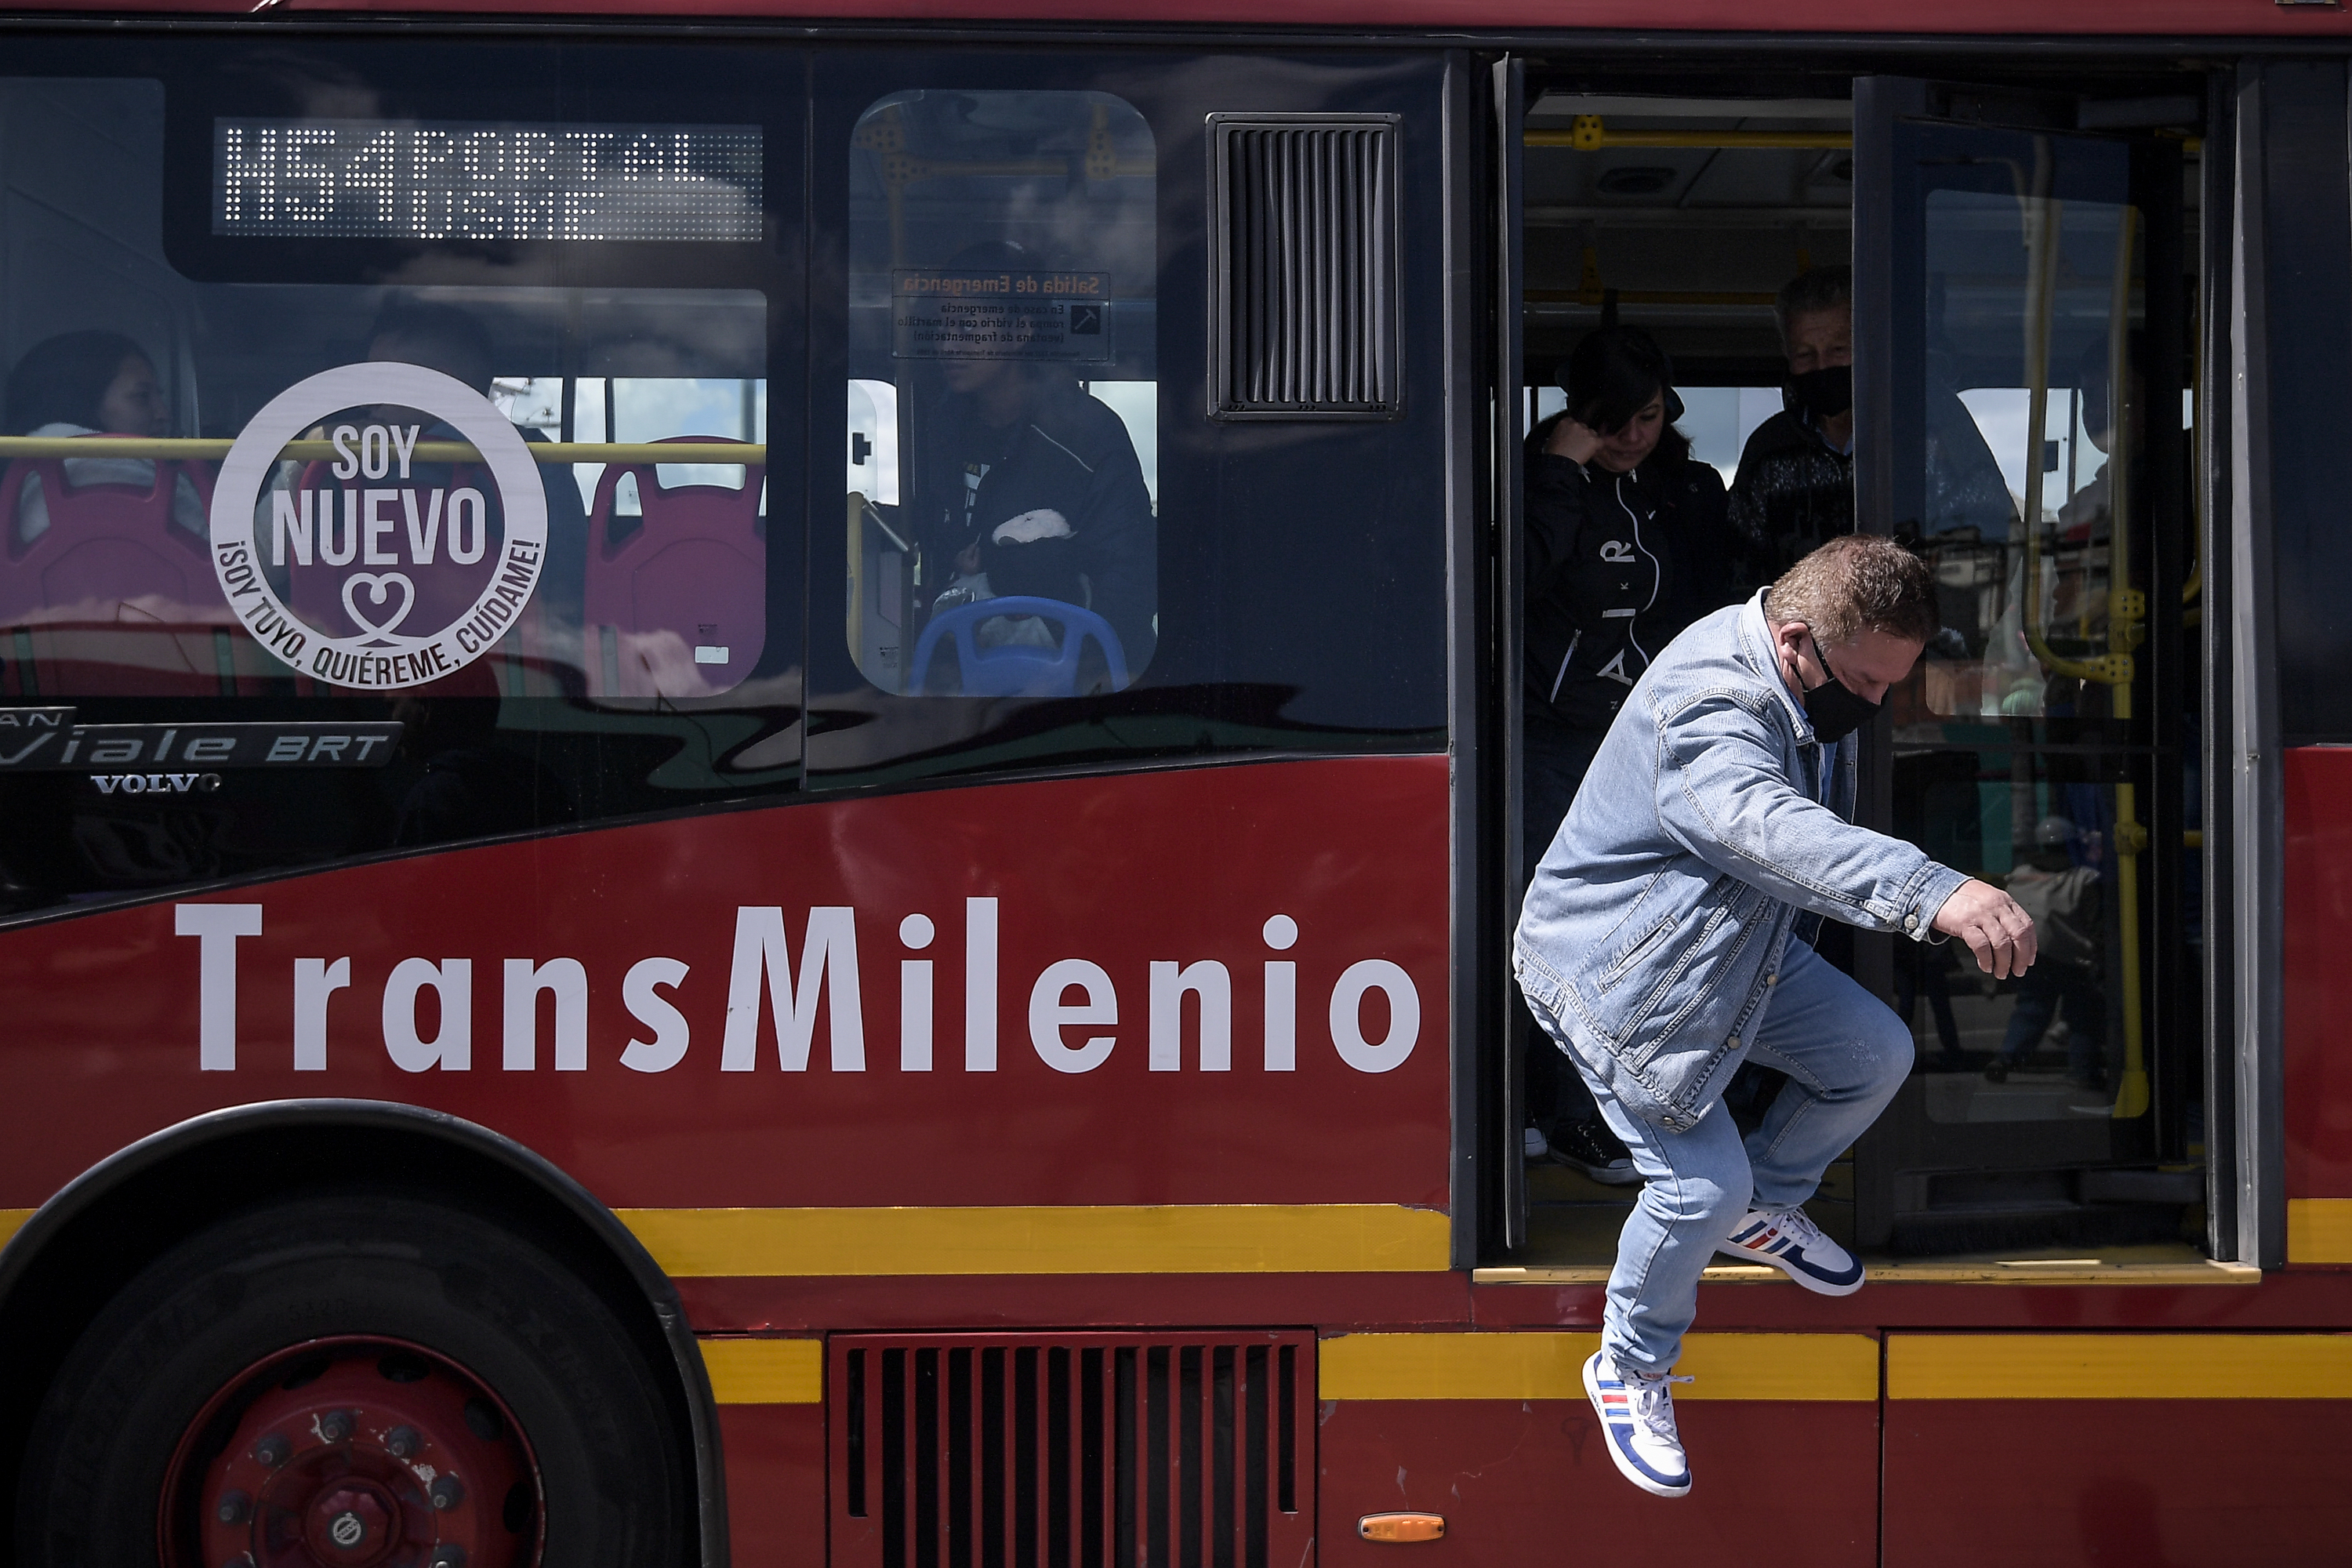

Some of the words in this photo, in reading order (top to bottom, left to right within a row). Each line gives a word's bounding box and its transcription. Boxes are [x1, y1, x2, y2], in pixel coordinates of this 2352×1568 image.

[226, 128, 395, 222] H54
[412, 130, 706, 182] PORTAL
[412, 191, 605, 240] USME
[332, 425, 421, 480] SOY
[272, 487, 486, 566] NUEVO
[245, 597, 308, 667] TUYO,
[312, 642, 462, 685] QUIÉREME,
[455, 538, 541, 654] CUÍDAME!
[265, 735, 390, 762] BRT
[175, 896, 1421, 1074] TransMilenio
